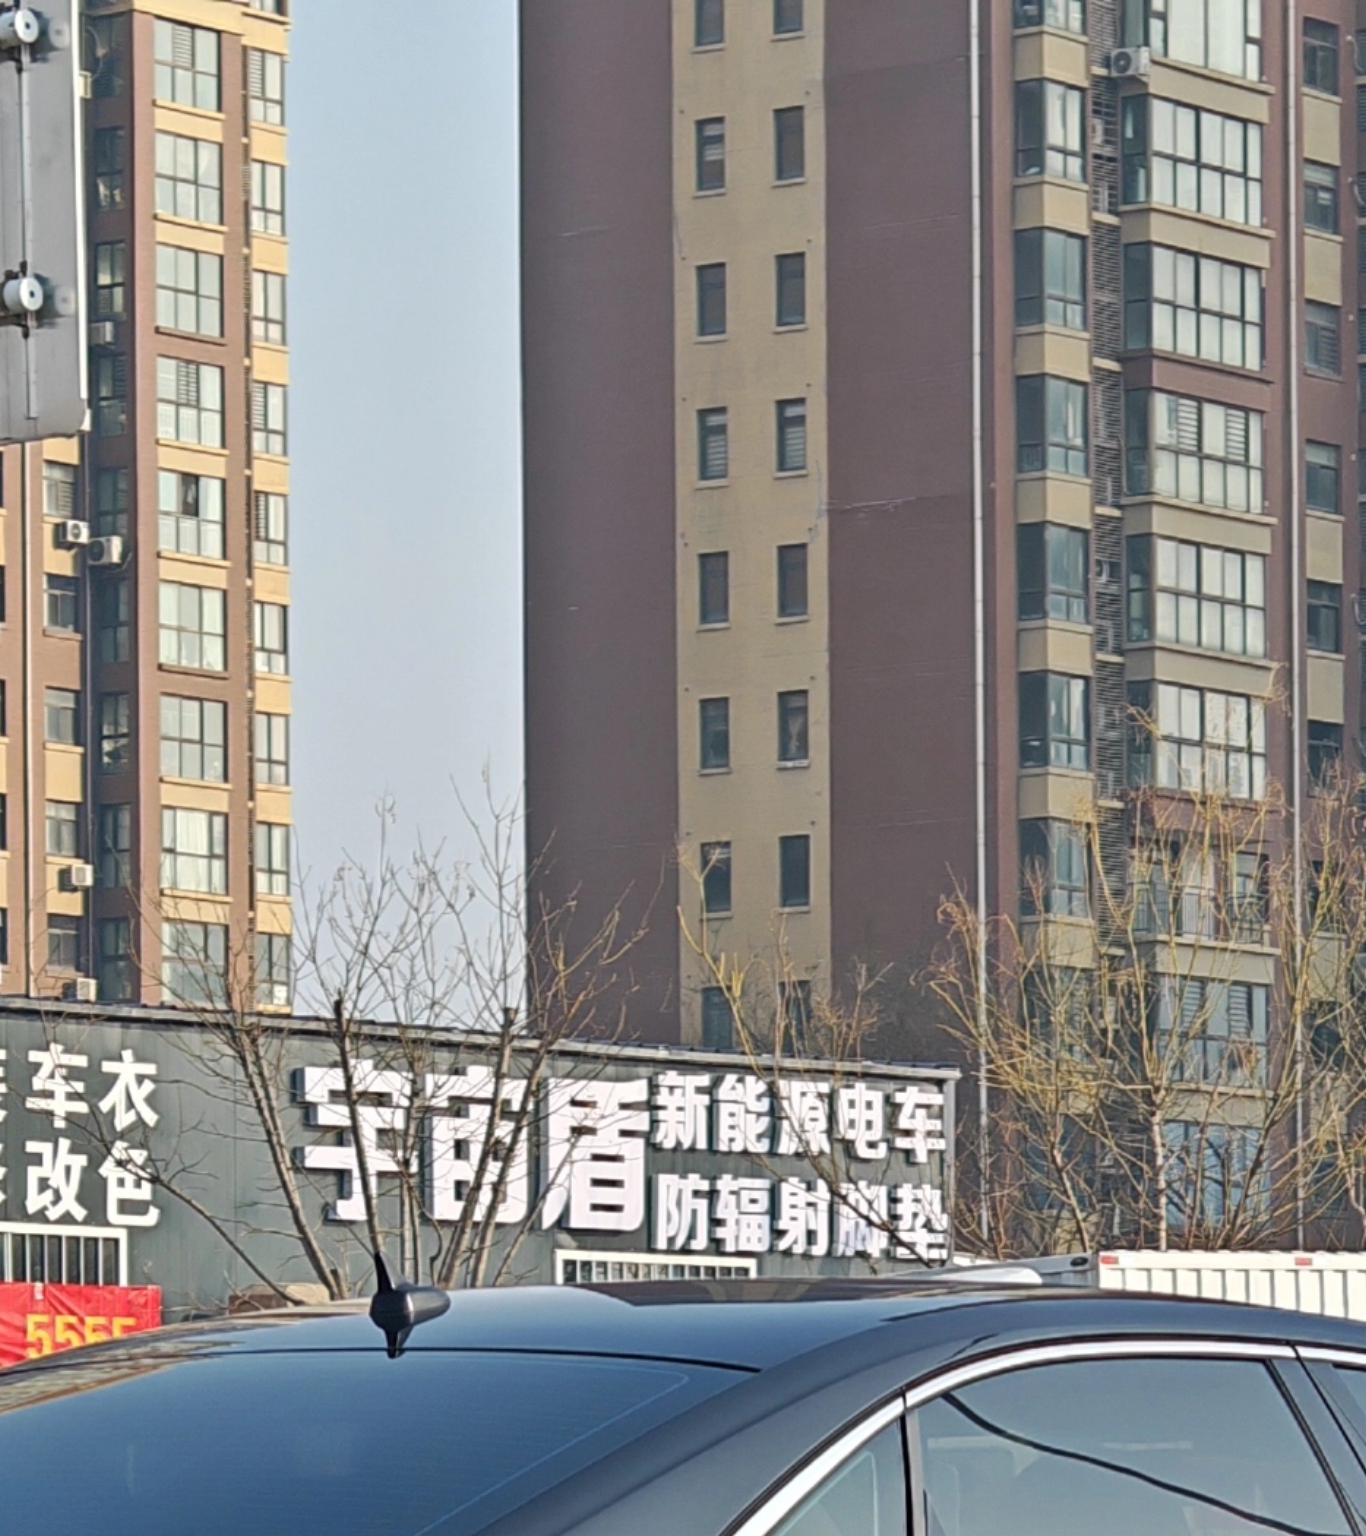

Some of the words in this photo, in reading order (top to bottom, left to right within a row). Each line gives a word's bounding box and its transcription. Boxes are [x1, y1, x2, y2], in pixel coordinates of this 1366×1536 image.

[295, 1058, 651, 1231] 宇宙盾
[653, 1070, 947, 1164] 新能源电车
[653, 1172, 949, 1260] 防辐射脚垫
